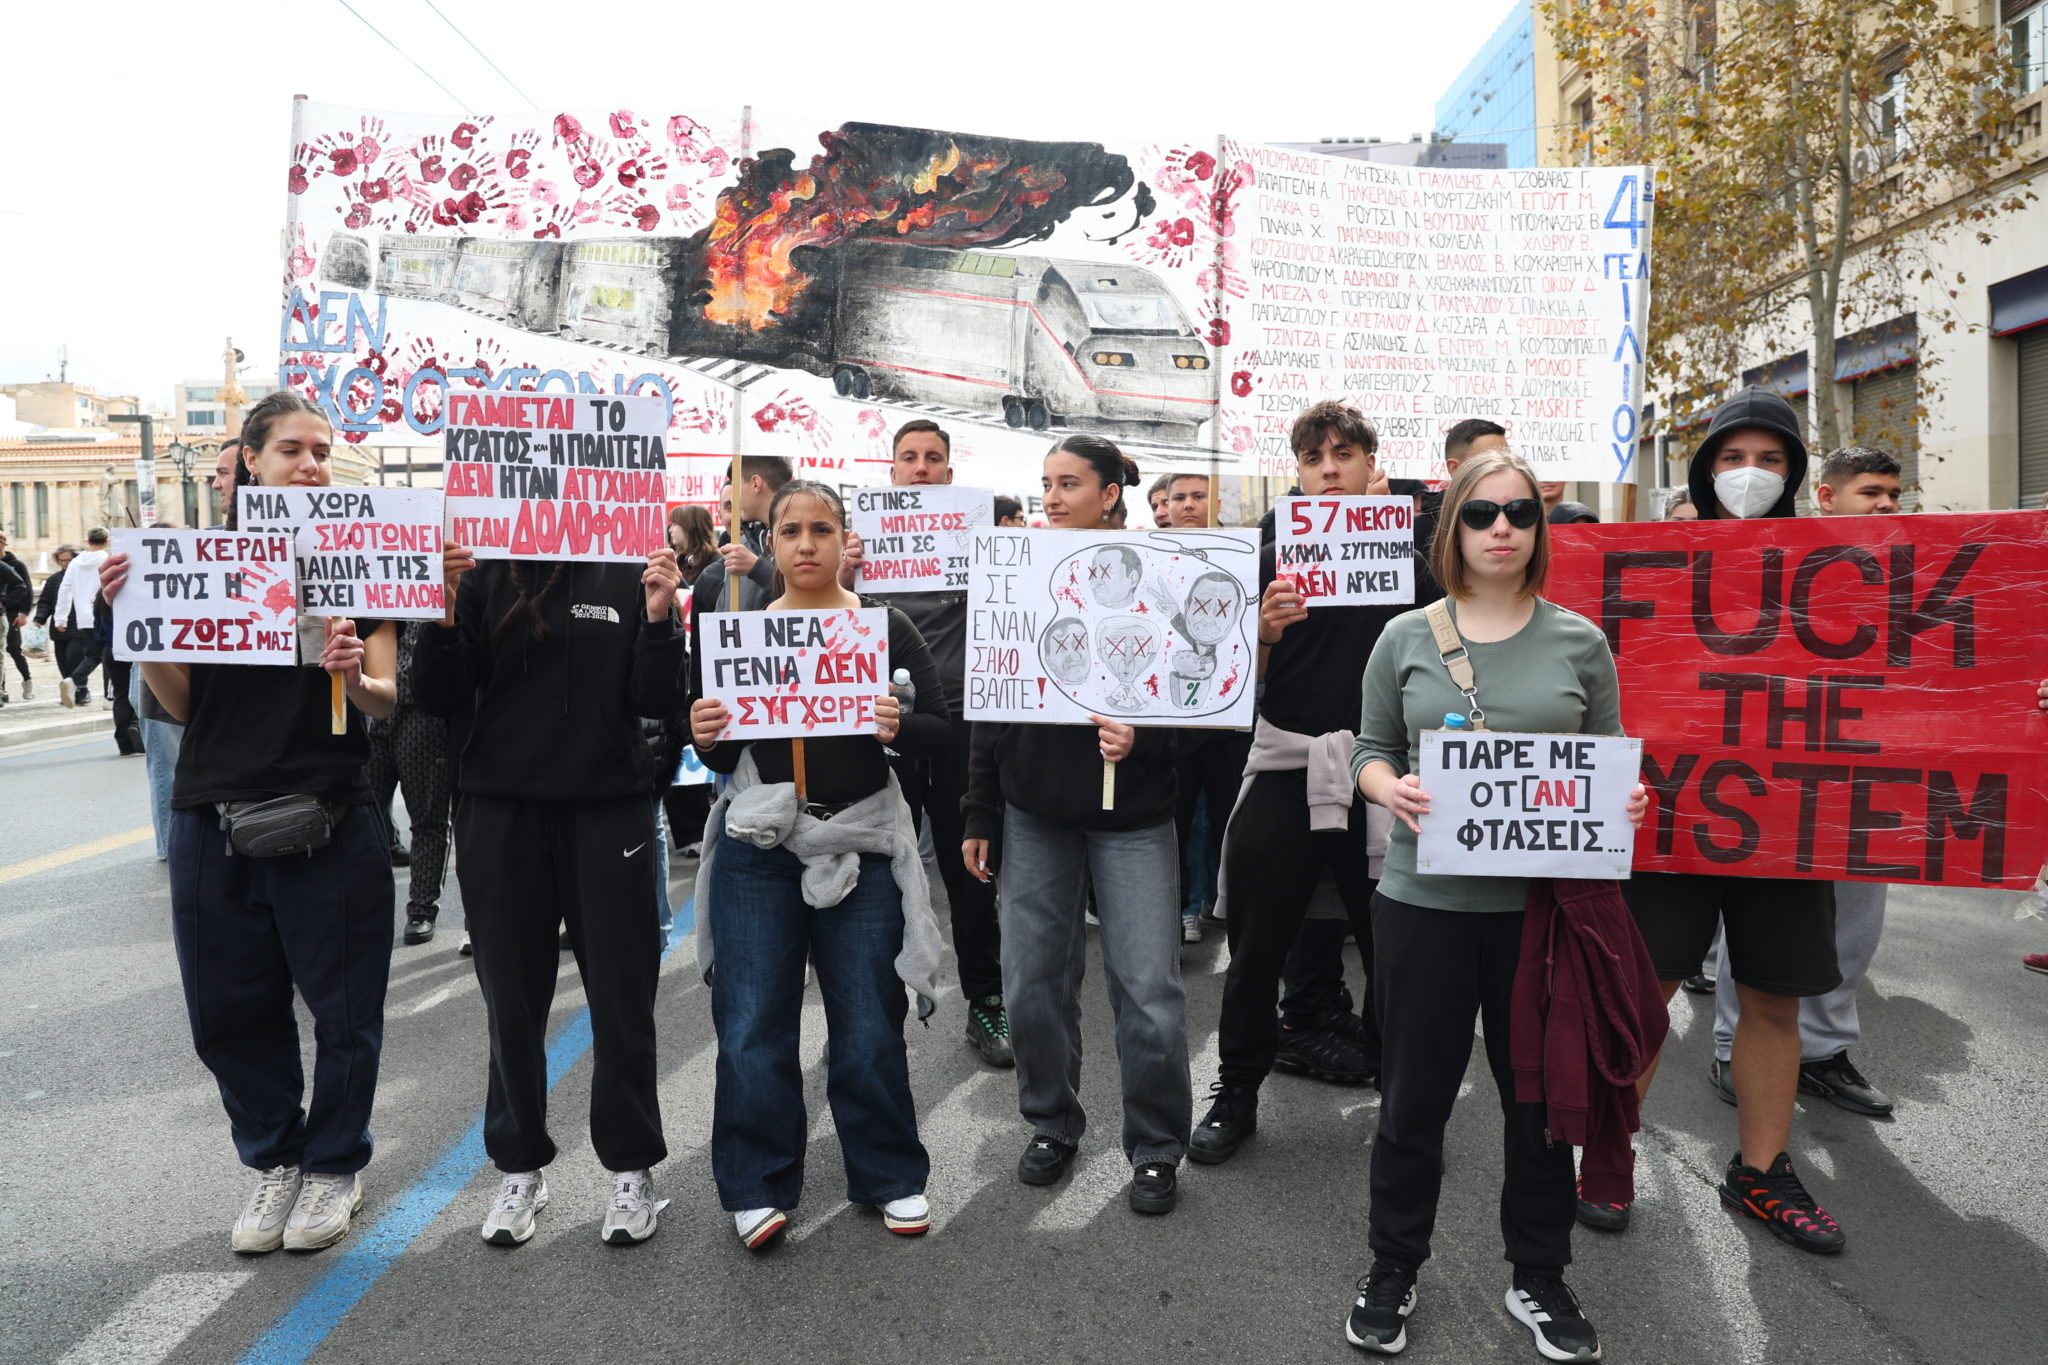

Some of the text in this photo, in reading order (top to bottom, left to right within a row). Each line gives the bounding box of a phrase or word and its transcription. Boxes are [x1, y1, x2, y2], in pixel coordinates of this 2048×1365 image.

[1344, 165, 1400, 185] ΜΗΤΣΚΑ
[1419, 172, 1484, 189] ΠΑΥΛΙΔΗΣ
[1509, 171, 1573, 188] ΤΖΟΒΑΡΑΣ
[1424, 192, 1498, 209] ΜΟΥΡΤΖΑΚΗ
[1347, 205, 1395, 226] ΡΟΥΤΣΙ
[1511, 214, 1586, 231] ΜΠΟΥΡΝΑΖΗΣ
[1429, 233, 1484, 250] ΚΟΥΛΕΛΑ
[1523, 235, 1575, 251] ΧΛΩΡΟΥ
[1437, 253, 1488, 272] ΒΛΑΧΟΣ
[1604, 252, 1649, 280] ΓΕΛ
[1262, 283, 1313, 302] ΜΠΕΖΑ
[281, 288, 387, 352] ΔΕΝ
[1251, 303, 1327, 325] ΠΑΠΑΖΟΓΛΟΥ
[1433, 316, 1488, 335] ΚΑΤΣΑΡΑ
[1262, 327, 1321, 348] ΤΣΙΝΤΖΑ
[1343, 332, 1408, 352] ΑΣΛΑΝΙΔΗΣ
[1438, 338, 1489, 355] ΕΝΤΡΙΣ
[1525, 358, 1571, 376] ΜΟΛΧΟ
[1269, 373, 1308, 391] ΛΑΤΑ
[1612, 283, 1642, 482] ΙΛΙΟΥ
[449, 394, 574, 430] ΓΑΜΙΕΤΑΙ
[590, 399, 626, 432] ΤΟ
[1351, 393, 1407, 412] ΧΟΥΠΑ
[446, 428, 533, 464] ΚΡΑΤΟΣ
[549, 433, 565, 466] Η
[567, 433, 667, 470] ΠΟΛΙΤΕΙΑ
[445, 463, 494, 498] ΔΕΝ
[500, 465, 558, 500] ΗΤΑΝ
[563, 468, 666, 504] ΑΤΥΧΗΜΑ
[246, 492, 375, 520] ΜΙΑ ΧΩΡΑ
[857, 491, 923, 512] ΕΓΙΝΕΣ
[453, 517, 510, 548] ΗΤΑΝ
[510, 499, 666, 557] ΔΟΛΟΦΟΝΙΑ
[880, 512, 967, 534] ΜΠΑΤΣΟΣ
[1291, 501, 1412, 535] 57 ΝΕΚΡΟΙ
[142, 537, 288, 564] ΤΑ ΚΕΡΔΗ
[315, 522, 442, 554] ΣΚΟΤΩΝΕΙ
[862, 535, 936, 554] ΓΙΑΤΙ ΣΕ
[975, 535, 1031, 566] ΜΕΣΑ
[1281, 541, 1414, 565] ΚΑΜΙΑ ΣΥΓΓΝΩΜΗ
[377, 555, 430, 581] ΤΗΣ
[861, 557, 942, 581] ΒΑΡΑΓΑΝΕ
[945, 572, 969, 587] ΣΧΟ
[144, 572, 209, 600] ΤΟΥΣ
[303, 583, 445, 609] ΕΧΕΙ ΜΕΛΛΟΝ
[985, 574, 1018, 604] ΣΕ
[1295, 570, 1399, 598] ΔΕΝ ΑΡΚΕΙ
[1601, 542, 1989, 669] FUCK
[126, 617, 293, 652] ΟΙ ΖΩΕΣ ΜΑΣ
[719, 616, 827, 648] Η ΝΕΑ
[973, 609, 1036, 643] ΕΝΑΝ
[714, 653, 878, 688] ΓΕΝΙΑ ΔΕΝ
[971, 646, 1020, 676] ΣΑΚΟ
[737, 694, 880, 726] ΣΥΓΧΩΡΕ
[1698, 672, 1885, 754] THE
[1442, 739, 1596, 771] ΠΑΡΕ ΜΕ
[1641, 754, 2008, 884] YSTEM
[1457, 818, 1626, 853] ΦΤΑΣΕΙΣ...
